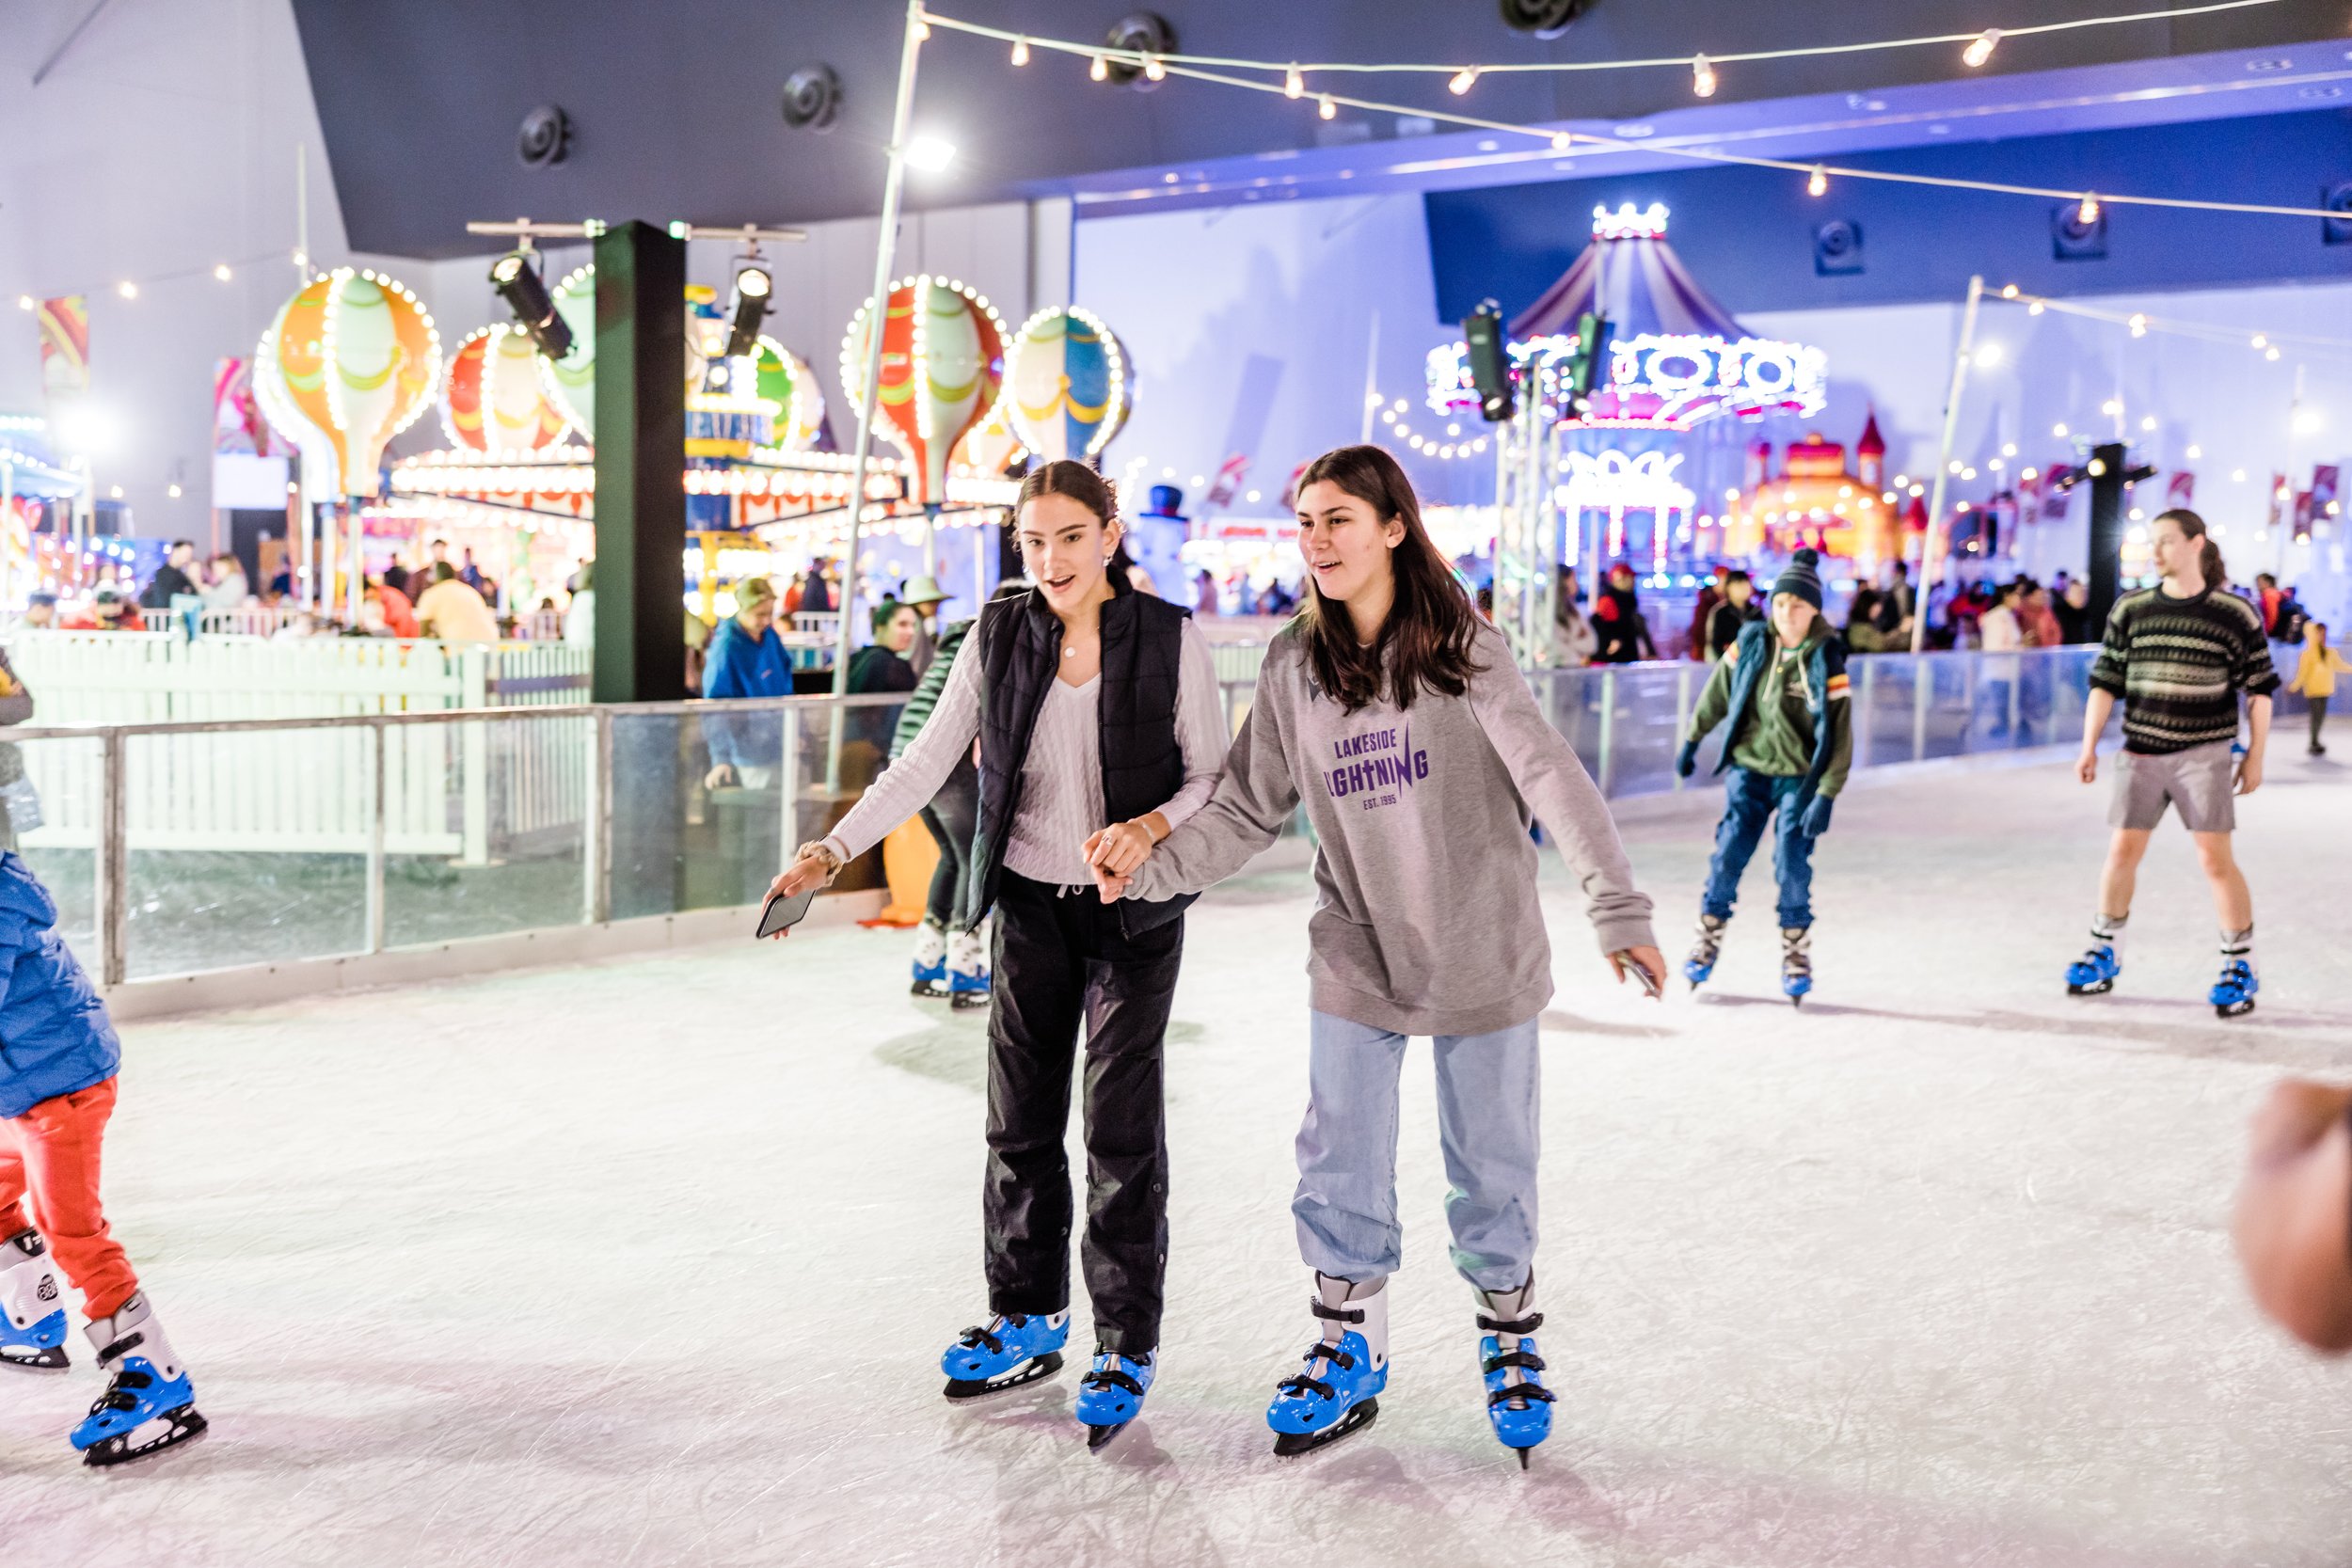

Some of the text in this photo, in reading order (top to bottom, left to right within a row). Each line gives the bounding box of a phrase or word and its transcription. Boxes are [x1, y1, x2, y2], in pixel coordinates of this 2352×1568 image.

[1334, 728, 1397, 759] LAKESIDE
[1324, 720, 1429, 799] GHTNING
[1363, 794, 1397, 810] EST. 1995
